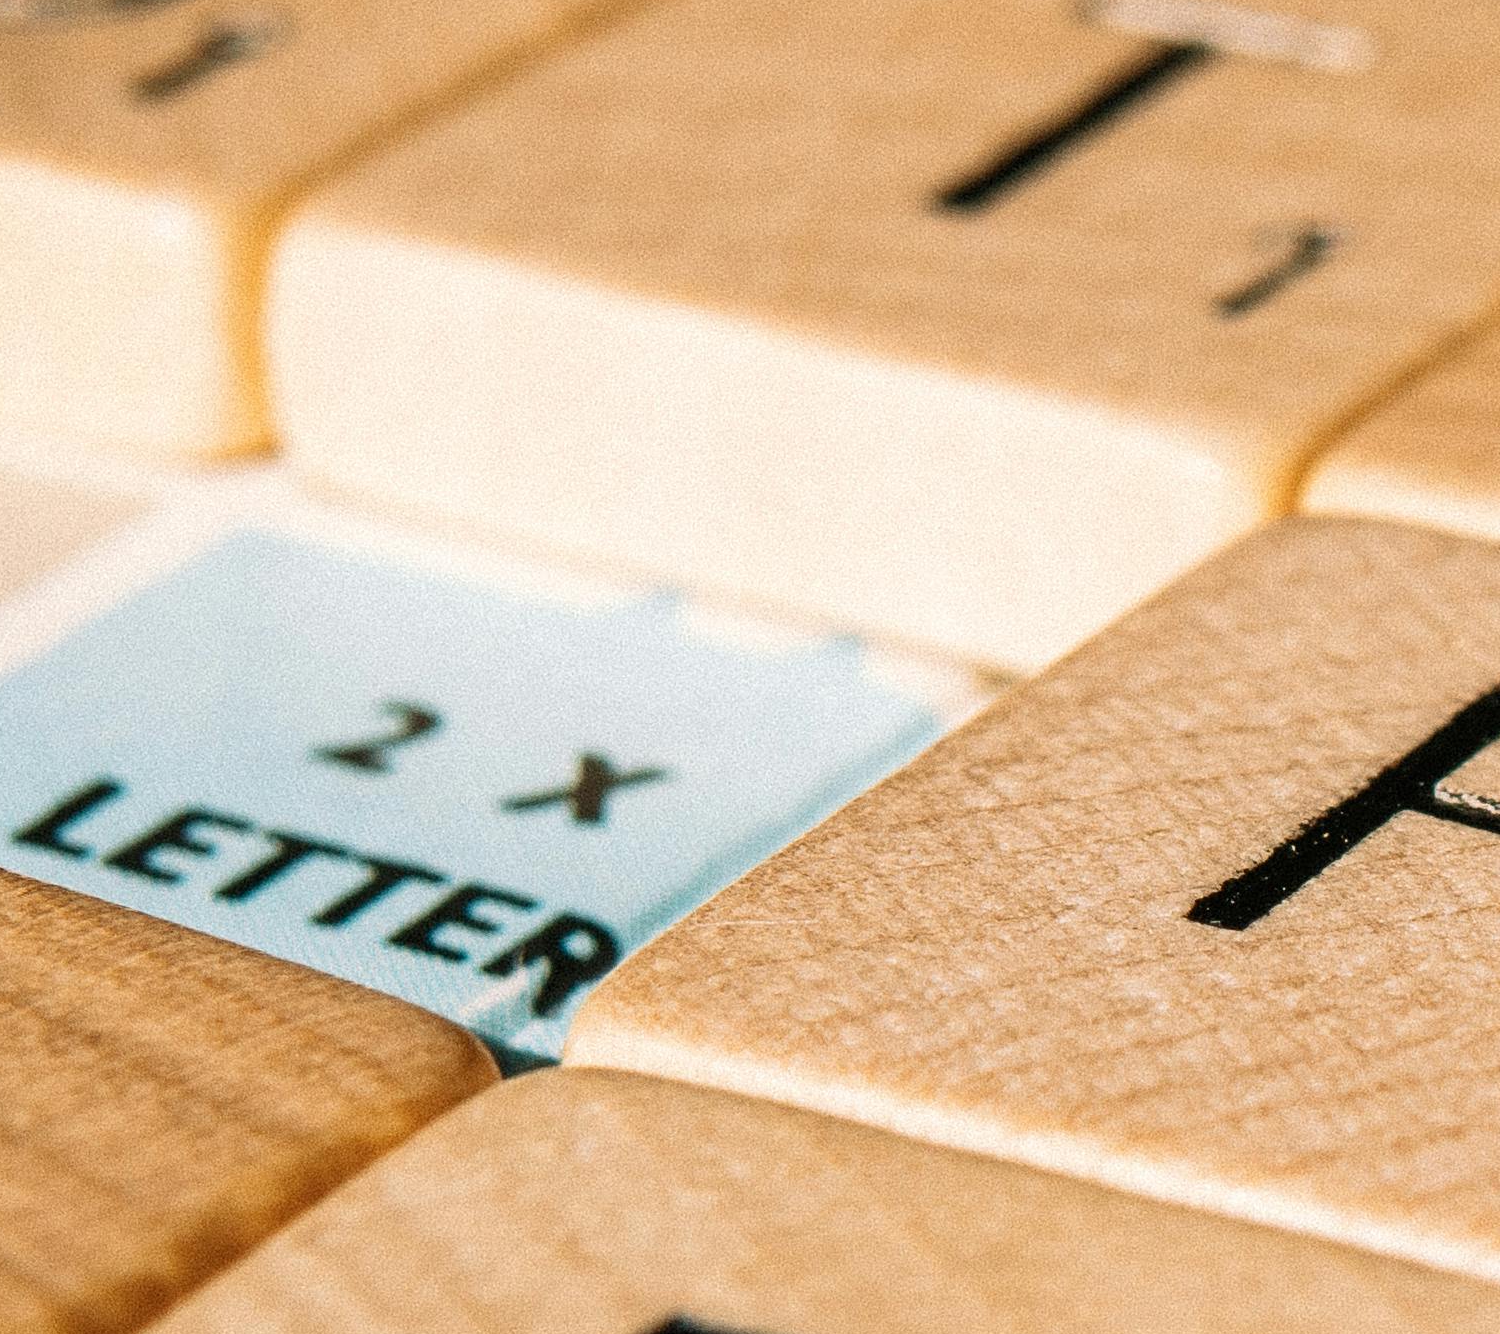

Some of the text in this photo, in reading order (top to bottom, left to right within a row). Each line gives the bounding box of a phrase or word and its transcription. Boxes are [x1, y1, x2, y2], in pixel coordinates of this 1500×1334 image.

[312, 699, 667, 826] 2 X
[13, 775, 621, 1017] LETTER
